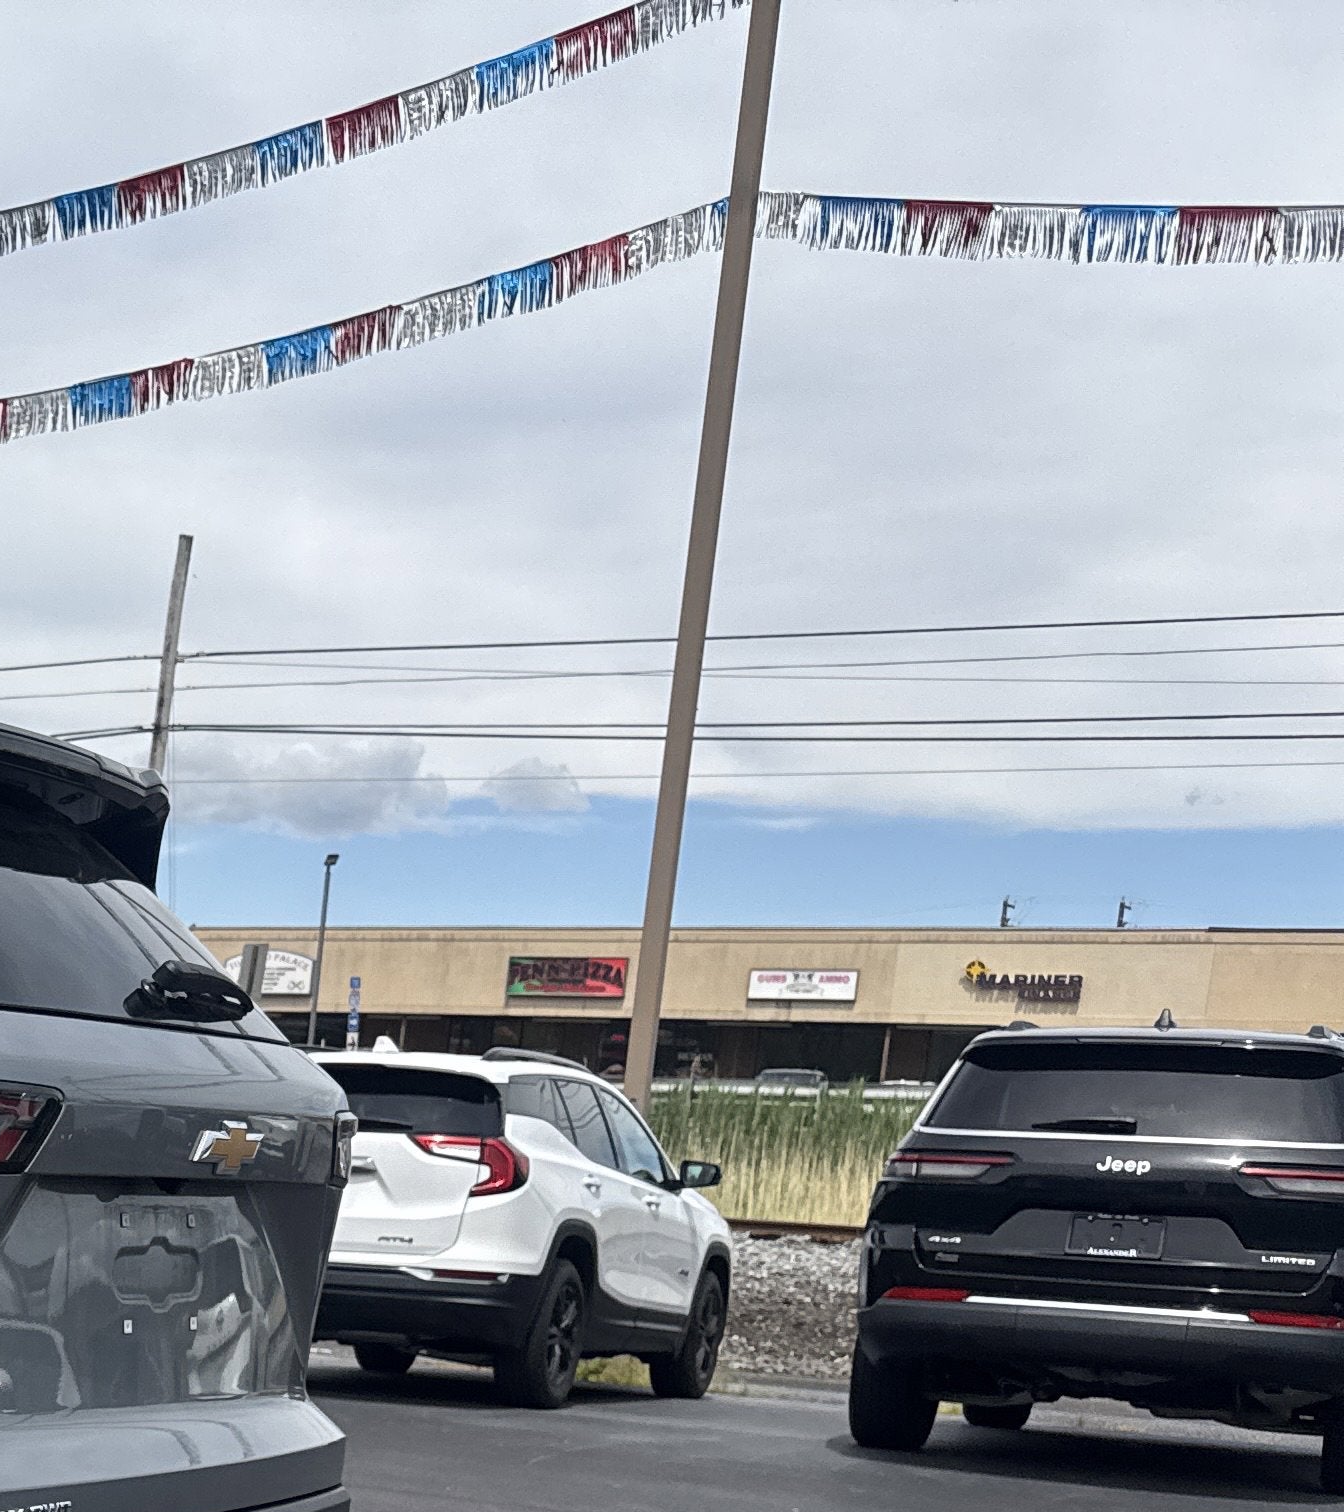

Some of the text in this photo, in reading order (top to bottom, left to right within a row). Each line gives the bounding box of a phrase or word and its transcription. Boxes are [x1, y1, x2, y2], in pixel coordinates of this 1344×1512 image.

[569, 961, 624, 988] PIZZA
[976, 973, 1083, 988] MARINER
[1096, 1156, 1151, 1176] Jeep
[1261, 1255, 1316, 1266] LIMITED
